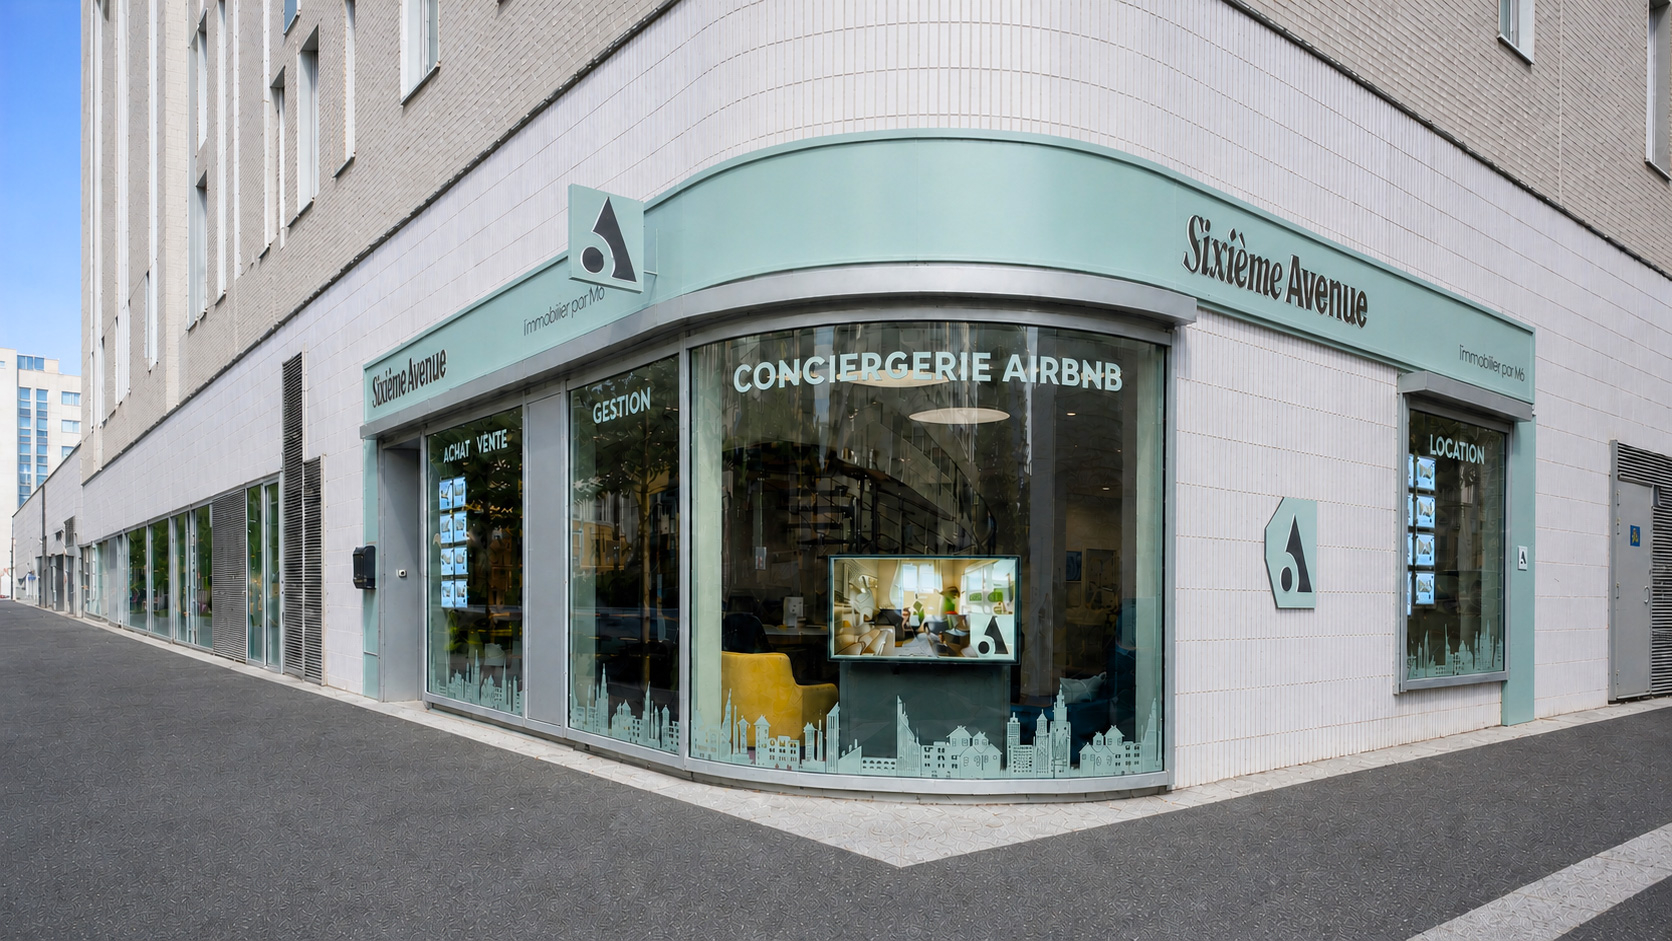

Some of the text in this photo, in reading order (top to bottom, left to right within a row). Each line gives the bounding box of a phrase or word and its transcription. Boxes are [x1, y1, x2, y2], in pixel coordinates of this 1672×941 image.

[1182, 214, 1368, 329] Sixième Avenue
[571, 294, 588, 318] par
[372, 349, 447, 408] Sixième Avenue
[733, 351, 1124, 393] CONCIERGERIE AIRBNB
[1501, 364, 1514, 378] par
[592, 386, 651, 424] GESTION
[443, 428, 508, 464] ACHAT VENTE
[1429, 434, 1485, 465] LOCATION
